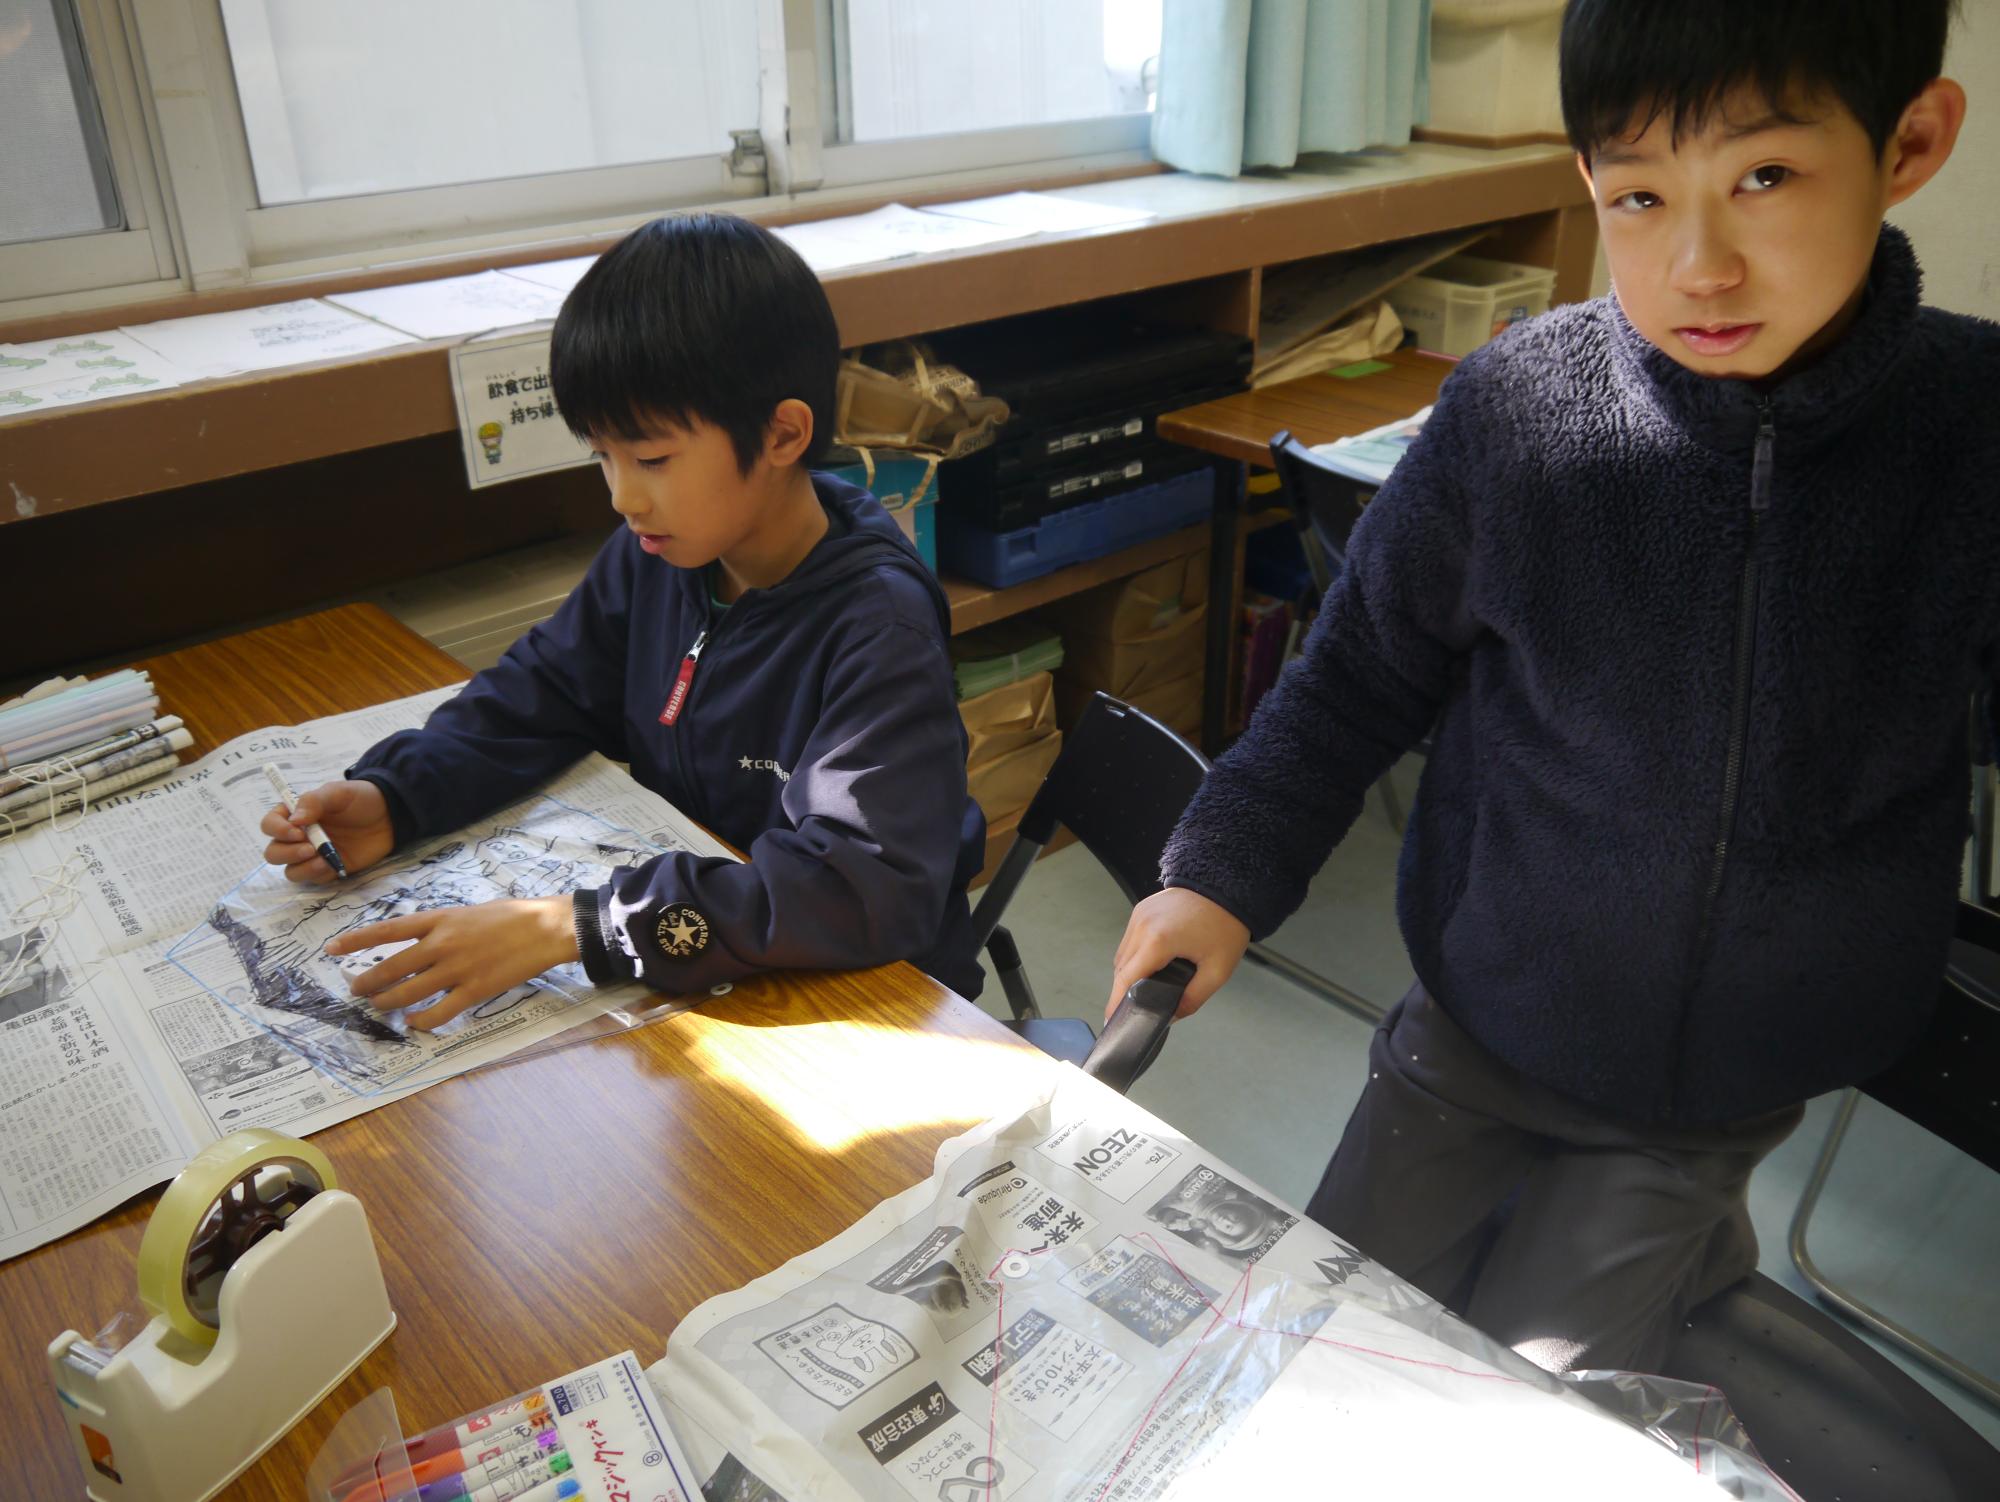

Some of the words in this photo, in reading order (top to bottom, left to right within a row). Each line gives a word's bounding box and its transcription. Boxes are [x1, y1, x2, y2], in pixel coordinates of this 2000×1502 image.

[488, 374, 554, 399] 飲食で出
[510, 402, 559, 425] 持ち帰
[664, 680, 686, 720] CONVERSE
[658, 938, 679, 956] STAR
[681, 908, 709, 950] CONVERSE
[70, 1006, 110, 1058] 原料は日本酒
[1073, 1127, 1137, 1176] ZEON
[1184, 1178, 1206, 1198] TAIYO
[1017, 1197, 1065, 1232] 前進。
[1052, 1345, 1102, 1399] 太平洋に
[867, 1404, 929, 1453] 東亞合成
